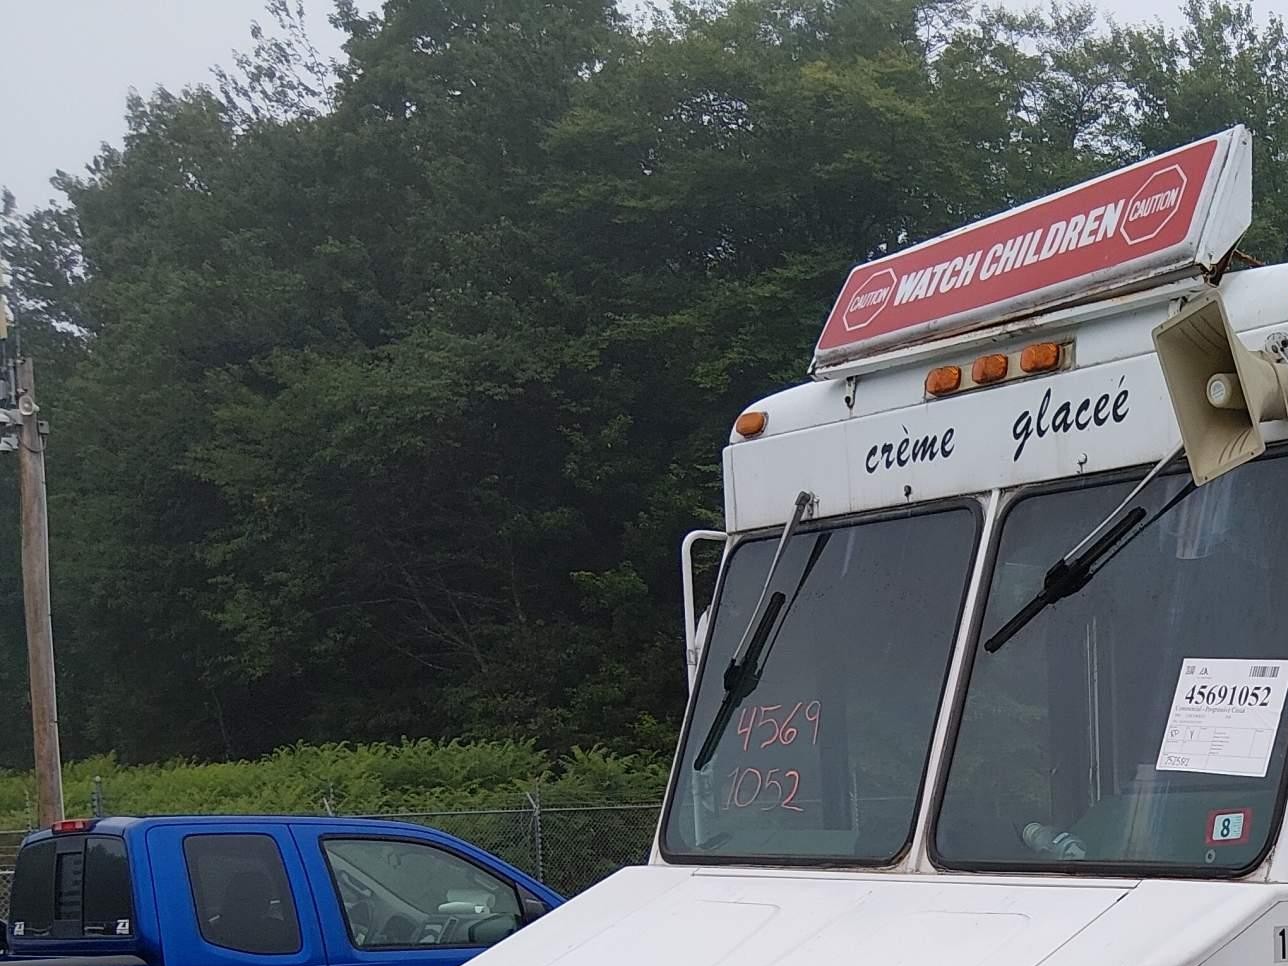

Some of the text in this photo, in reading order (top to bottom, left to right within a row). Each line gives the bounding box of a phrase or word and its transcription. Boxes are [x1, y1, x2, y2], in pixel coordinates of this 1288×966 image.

[1129, 187, 1180, 221] CAUTION
[893, 199, 1126, 306] WATCH CHILDREN
[850, 286, 890, 312] CAUTION
[865, 424, 955, 474] crème
[1185, 685, 1272, 707] 45691052
[737, 700, 821, 752] 4569
[721, 768, 804, 811] 1052
[1220, 817, 1231, 837] 8
